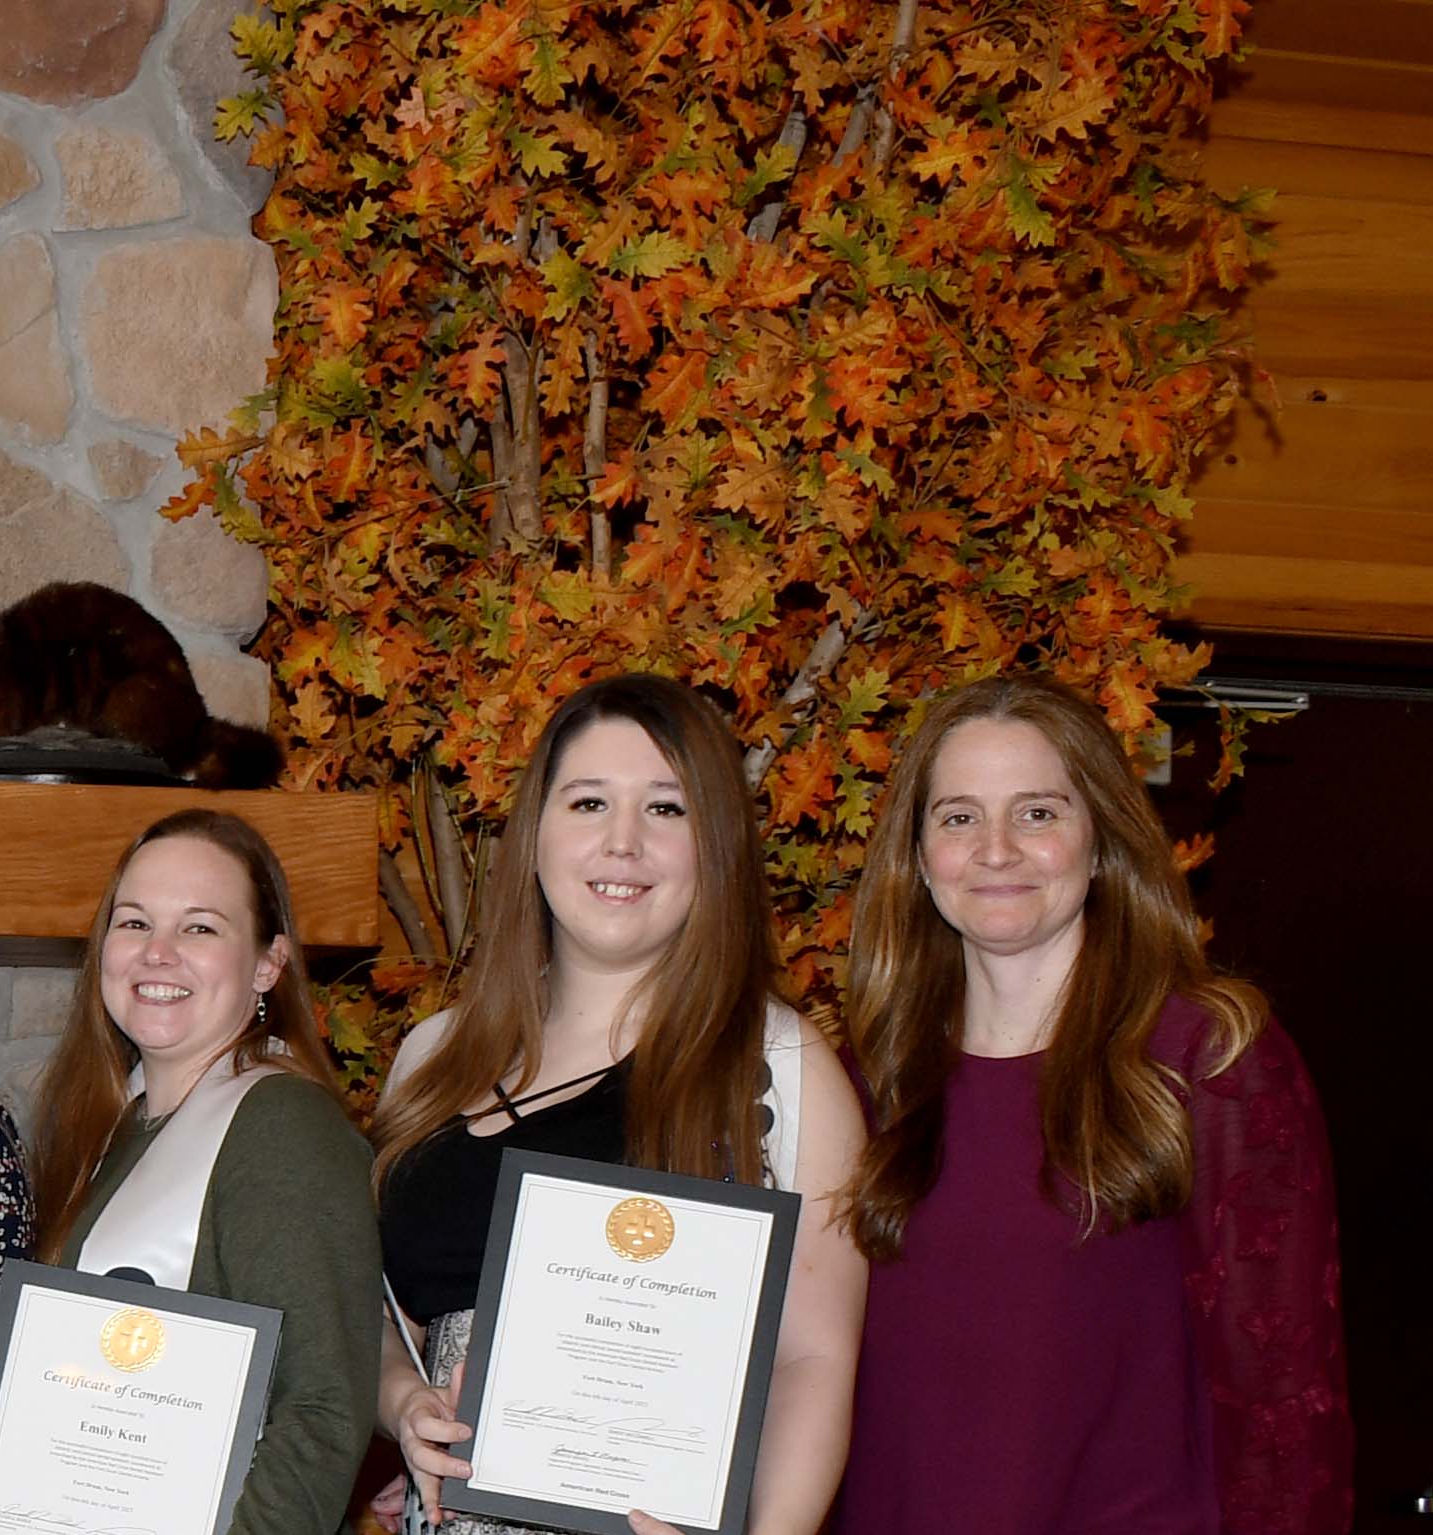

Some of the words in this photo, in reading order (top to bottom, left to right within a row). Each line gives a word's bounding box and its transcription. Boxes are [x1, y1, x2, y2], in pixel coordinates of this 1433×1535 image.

[547, 1262, 620, 1285] Certificate
[622, 1275, 640, 1290] of
[639, 1277, 718, 1301] Completion
[585, 1313, 622, 1332] Bailey
[627, 1321, 661, 1335] Shaw
[43, 1370, 111, 1393] Certificate
[114, 1384, 131, 1399] of
[130, 1387, 203, 1411] Completion
[80, 1420, 115, 1439] Emily
[118, 1428, 147, 1444] Kent
